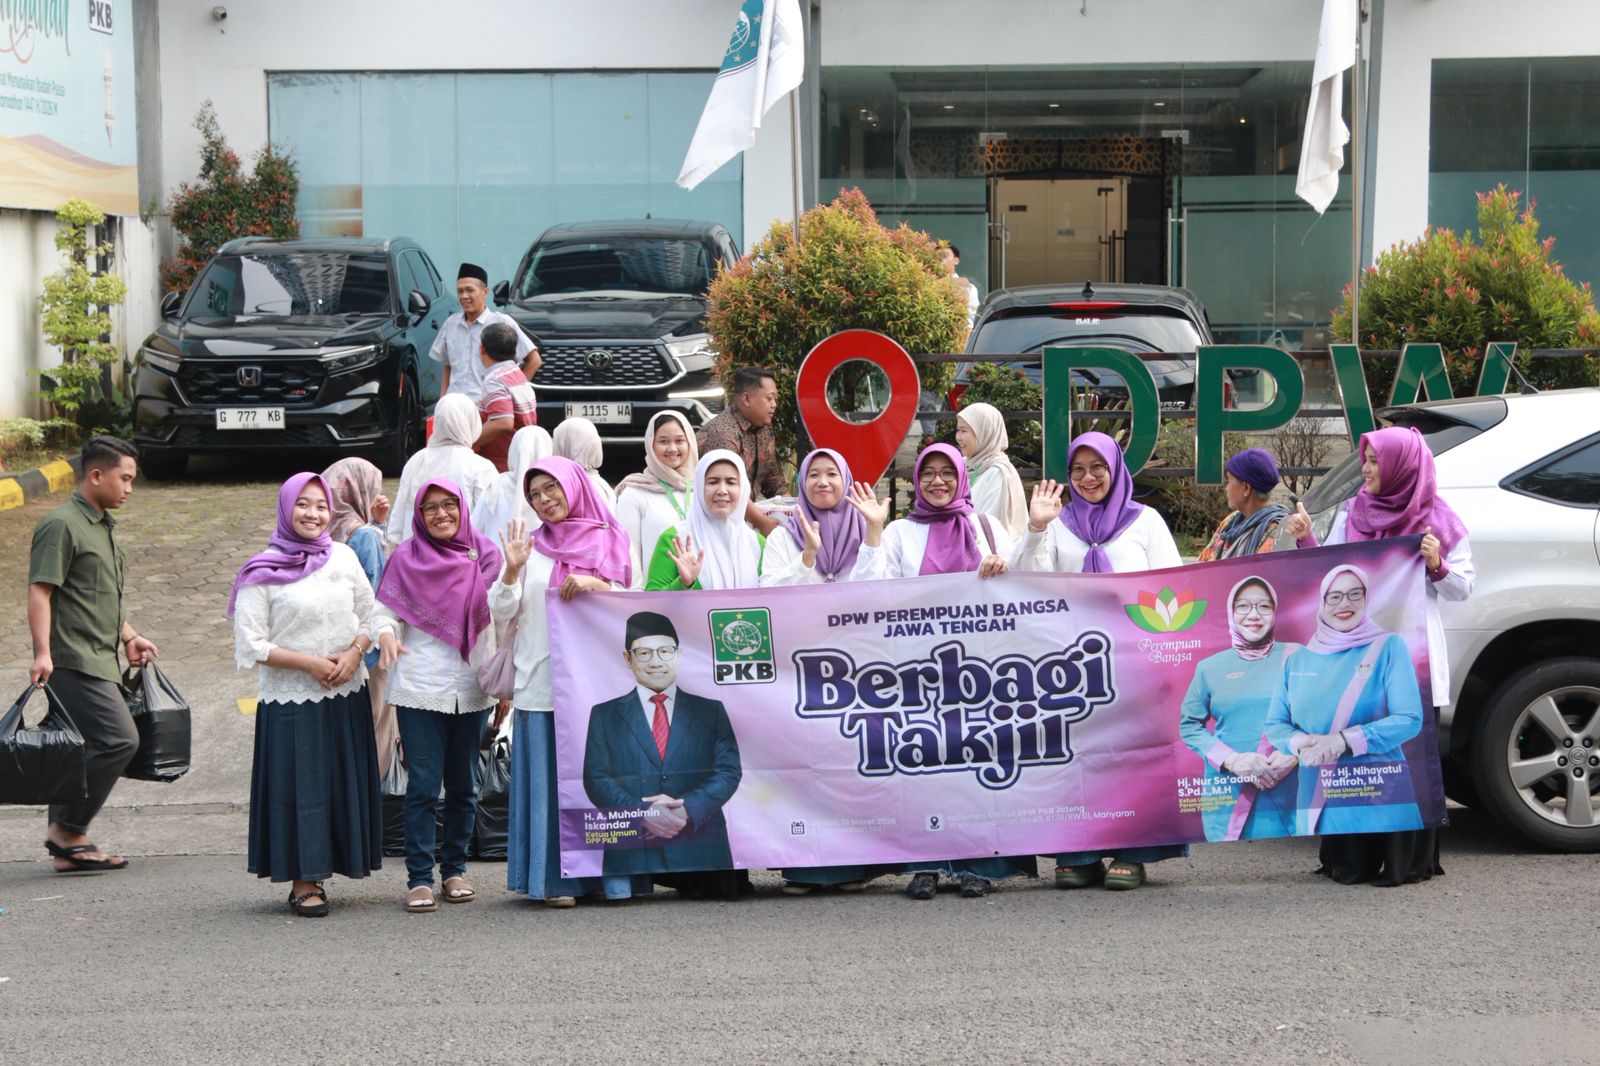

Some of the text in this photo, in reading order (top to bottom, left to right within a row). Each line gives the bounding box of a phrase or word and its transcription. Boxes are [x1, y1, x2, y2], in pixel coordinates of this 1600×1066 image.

[89, 0, 112, 29] PKB
[219, 410, 281, 422] G 777 KB
[566, 404, 631, 416] H 1115 WA
[828, 599, 1069, 627] DPW PEREMPUAN BANGSA
[883, 617, 1016, 638] JAWA TENGAH
[1138, 638, 1201, 652] Perempuan
[1148, 650, 1192, 667] Bangsa
[716, 662, 774, 682] PKB
[796, 636, 1110, 713] Berbagi
[846, 702, 1068, 785] Takjil
[1320, 764, 1402, 778] Dr. Hj. Nihayatul
[1177, 777, 1191, 789] Hj.
[1193, 777, 1212, 786] Nur
[1321, 776, 1384, 787] Wafiroh, MA
[584, 808, 660, 821] H. A. Muhaimin
[876, 816, 897, 825] 2026
[1094, 810, 1135, 820] Manyaran
[584, 820, 631, 831] Iskandar
[610, 829, 637, 837] Umum
